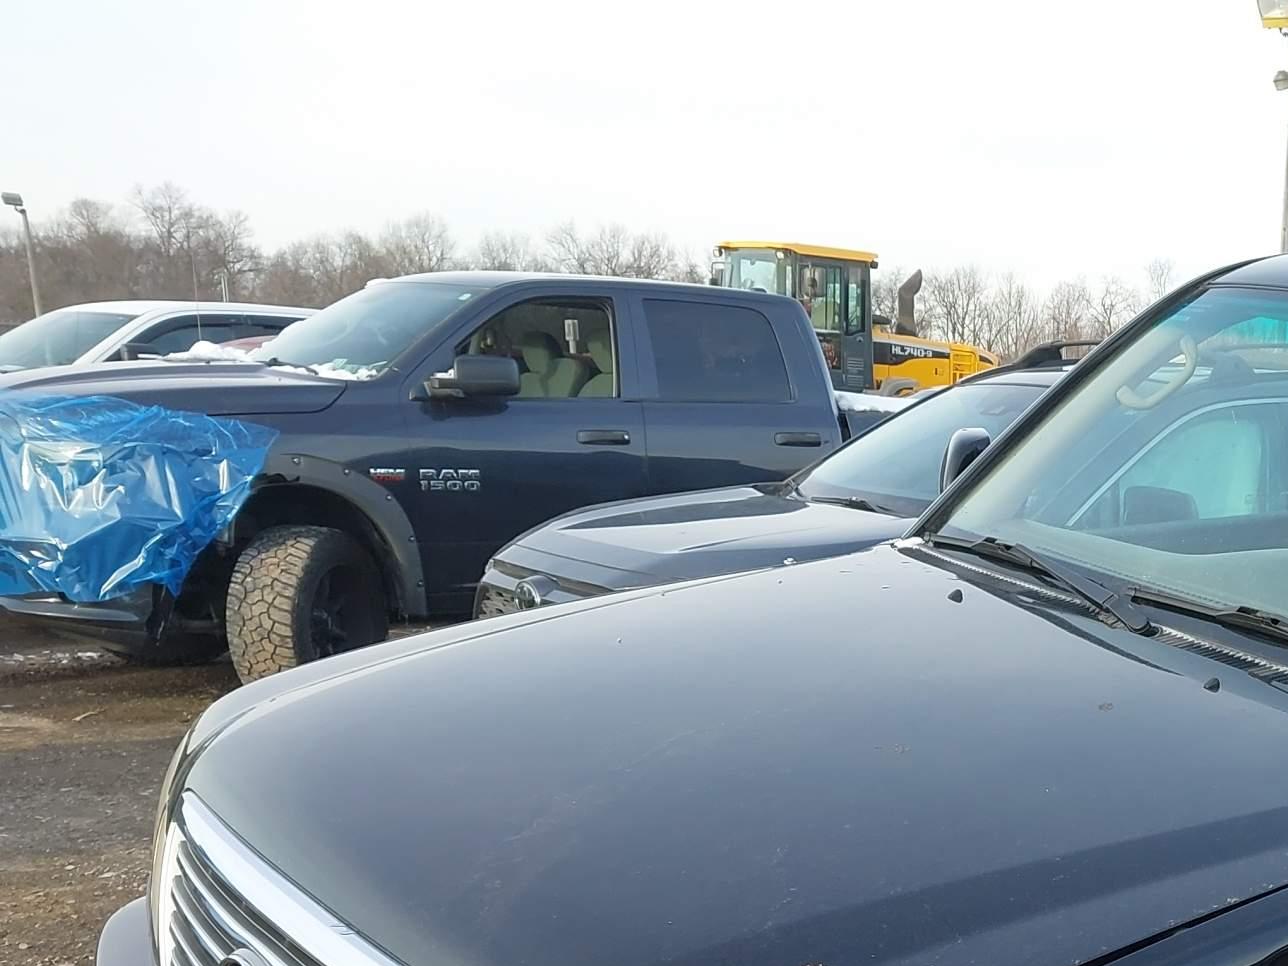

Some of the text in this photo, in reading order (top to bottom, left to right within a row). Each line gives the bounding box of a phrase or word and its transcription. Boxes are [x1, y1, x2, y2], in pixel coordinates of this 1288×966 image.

[891, 345, 933, 358] HL740-9
[419, 468, 480, 480] RAM
[419, 480, 480, 491] 1500
